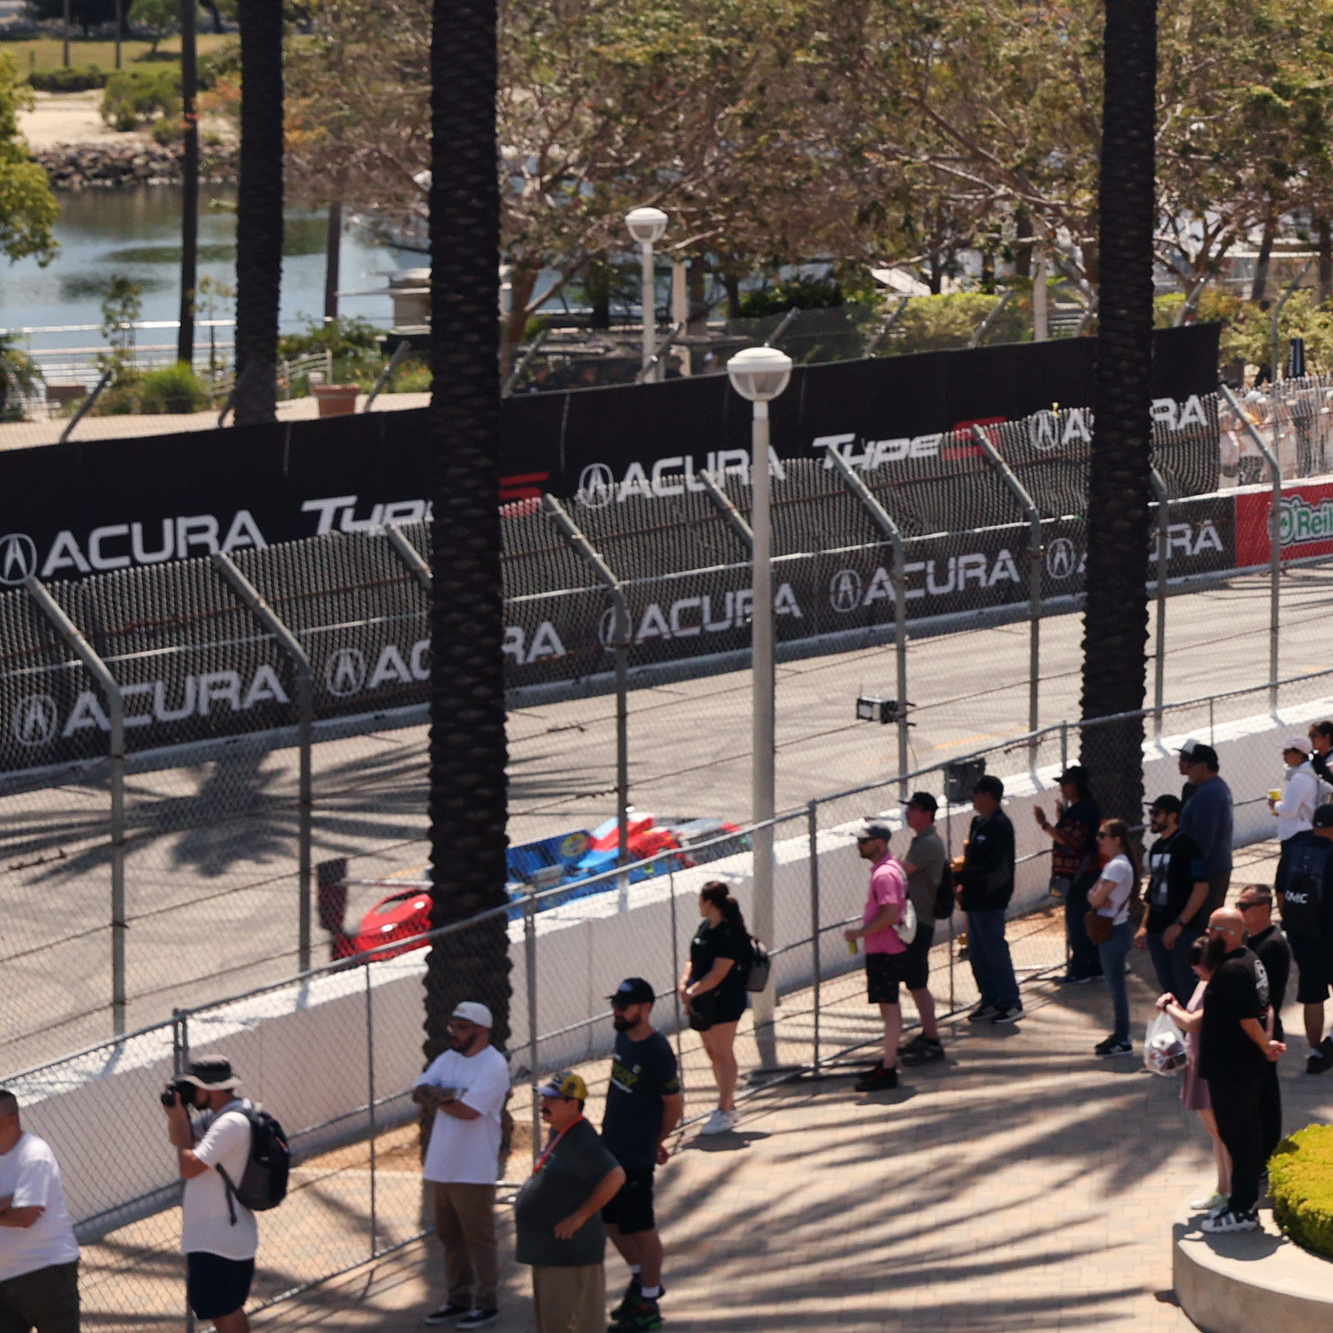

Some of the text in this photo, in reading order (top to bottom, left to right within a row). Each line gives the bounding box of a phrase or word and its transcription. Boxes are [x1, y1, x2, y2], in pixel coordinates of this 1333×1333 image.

[41, 509, 268, 578] ACURA
[861, 547, 1021, 607] ACURA
[634, 581, 804, 645] ACURA
[61, 663, 290, 739] ACURA
